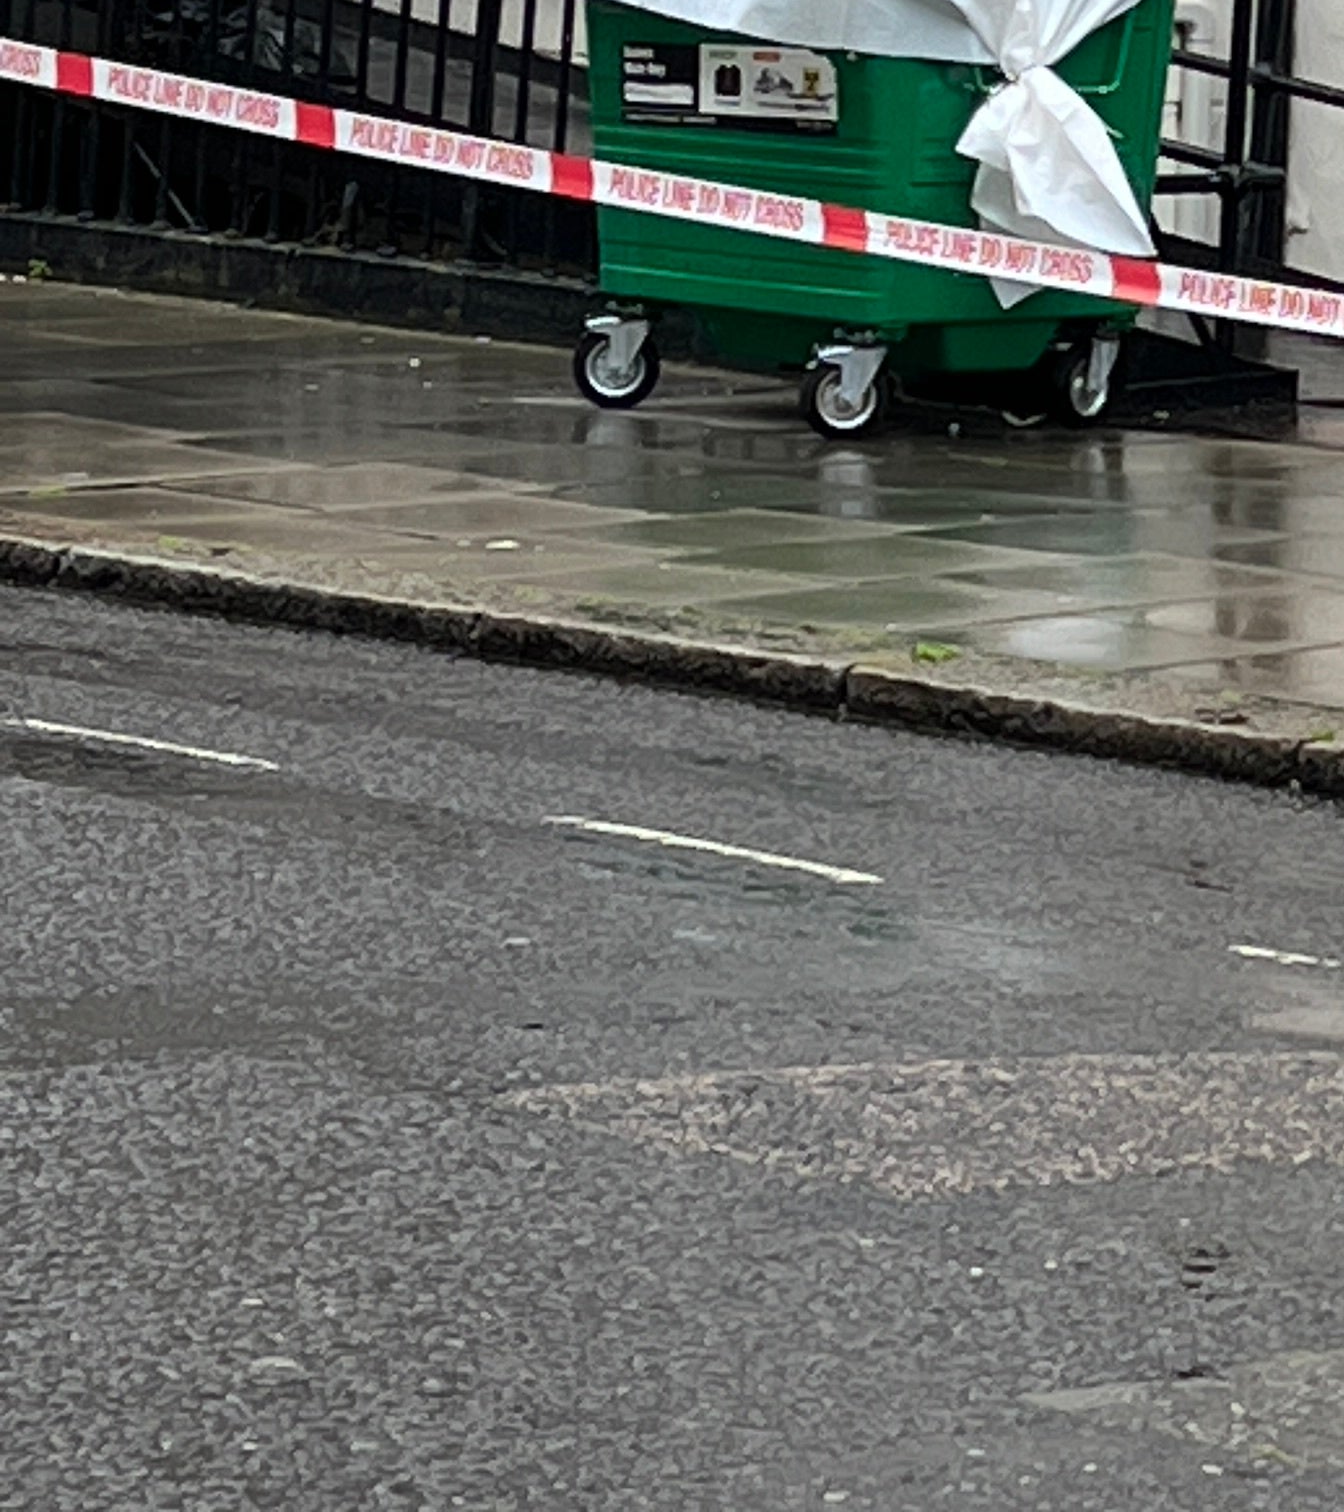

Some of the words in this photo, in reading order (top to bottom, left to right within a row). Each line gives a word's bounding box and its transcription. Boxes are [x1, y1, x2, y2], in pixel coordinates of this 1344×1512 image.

[109, 67, 150, 102] POLICE
[153, 77, 184, 107] LINE
[184, 84, 204, 112] DO
[206, 88, 233, 117] NOT
[235, 93, 280, 128] CROSS
[351, 118, 397, 152] POLICE
[400, 126, 431, 158] LINE
[433, 133, 454, 162] DO
[455, 139, 485, 169] NOT
[486, 145, 534, 179] CROSS
[609, 168, 661, 205] POLICE
[662, 180, 697, 210] LINE
[697, 184, 720, 213] DO
[721, 191, 752, 221] NOT
[753, 196, 803, 231] CROSS
[884, 220, 941, 254] POLICE
[941, 230, 977, 261] LINE
[979, 236, 1003, 267] DO
[1004, 242, 1037, 273] NOT
[1039, 246, 1092, 284] CROSS
[1176, 272, 1237, 309] POLICE
[1239, 282, 1276, 314] LINE
[1278, 289, 1304, 319] DO
[1306, 294, 1340, 325] NOT
